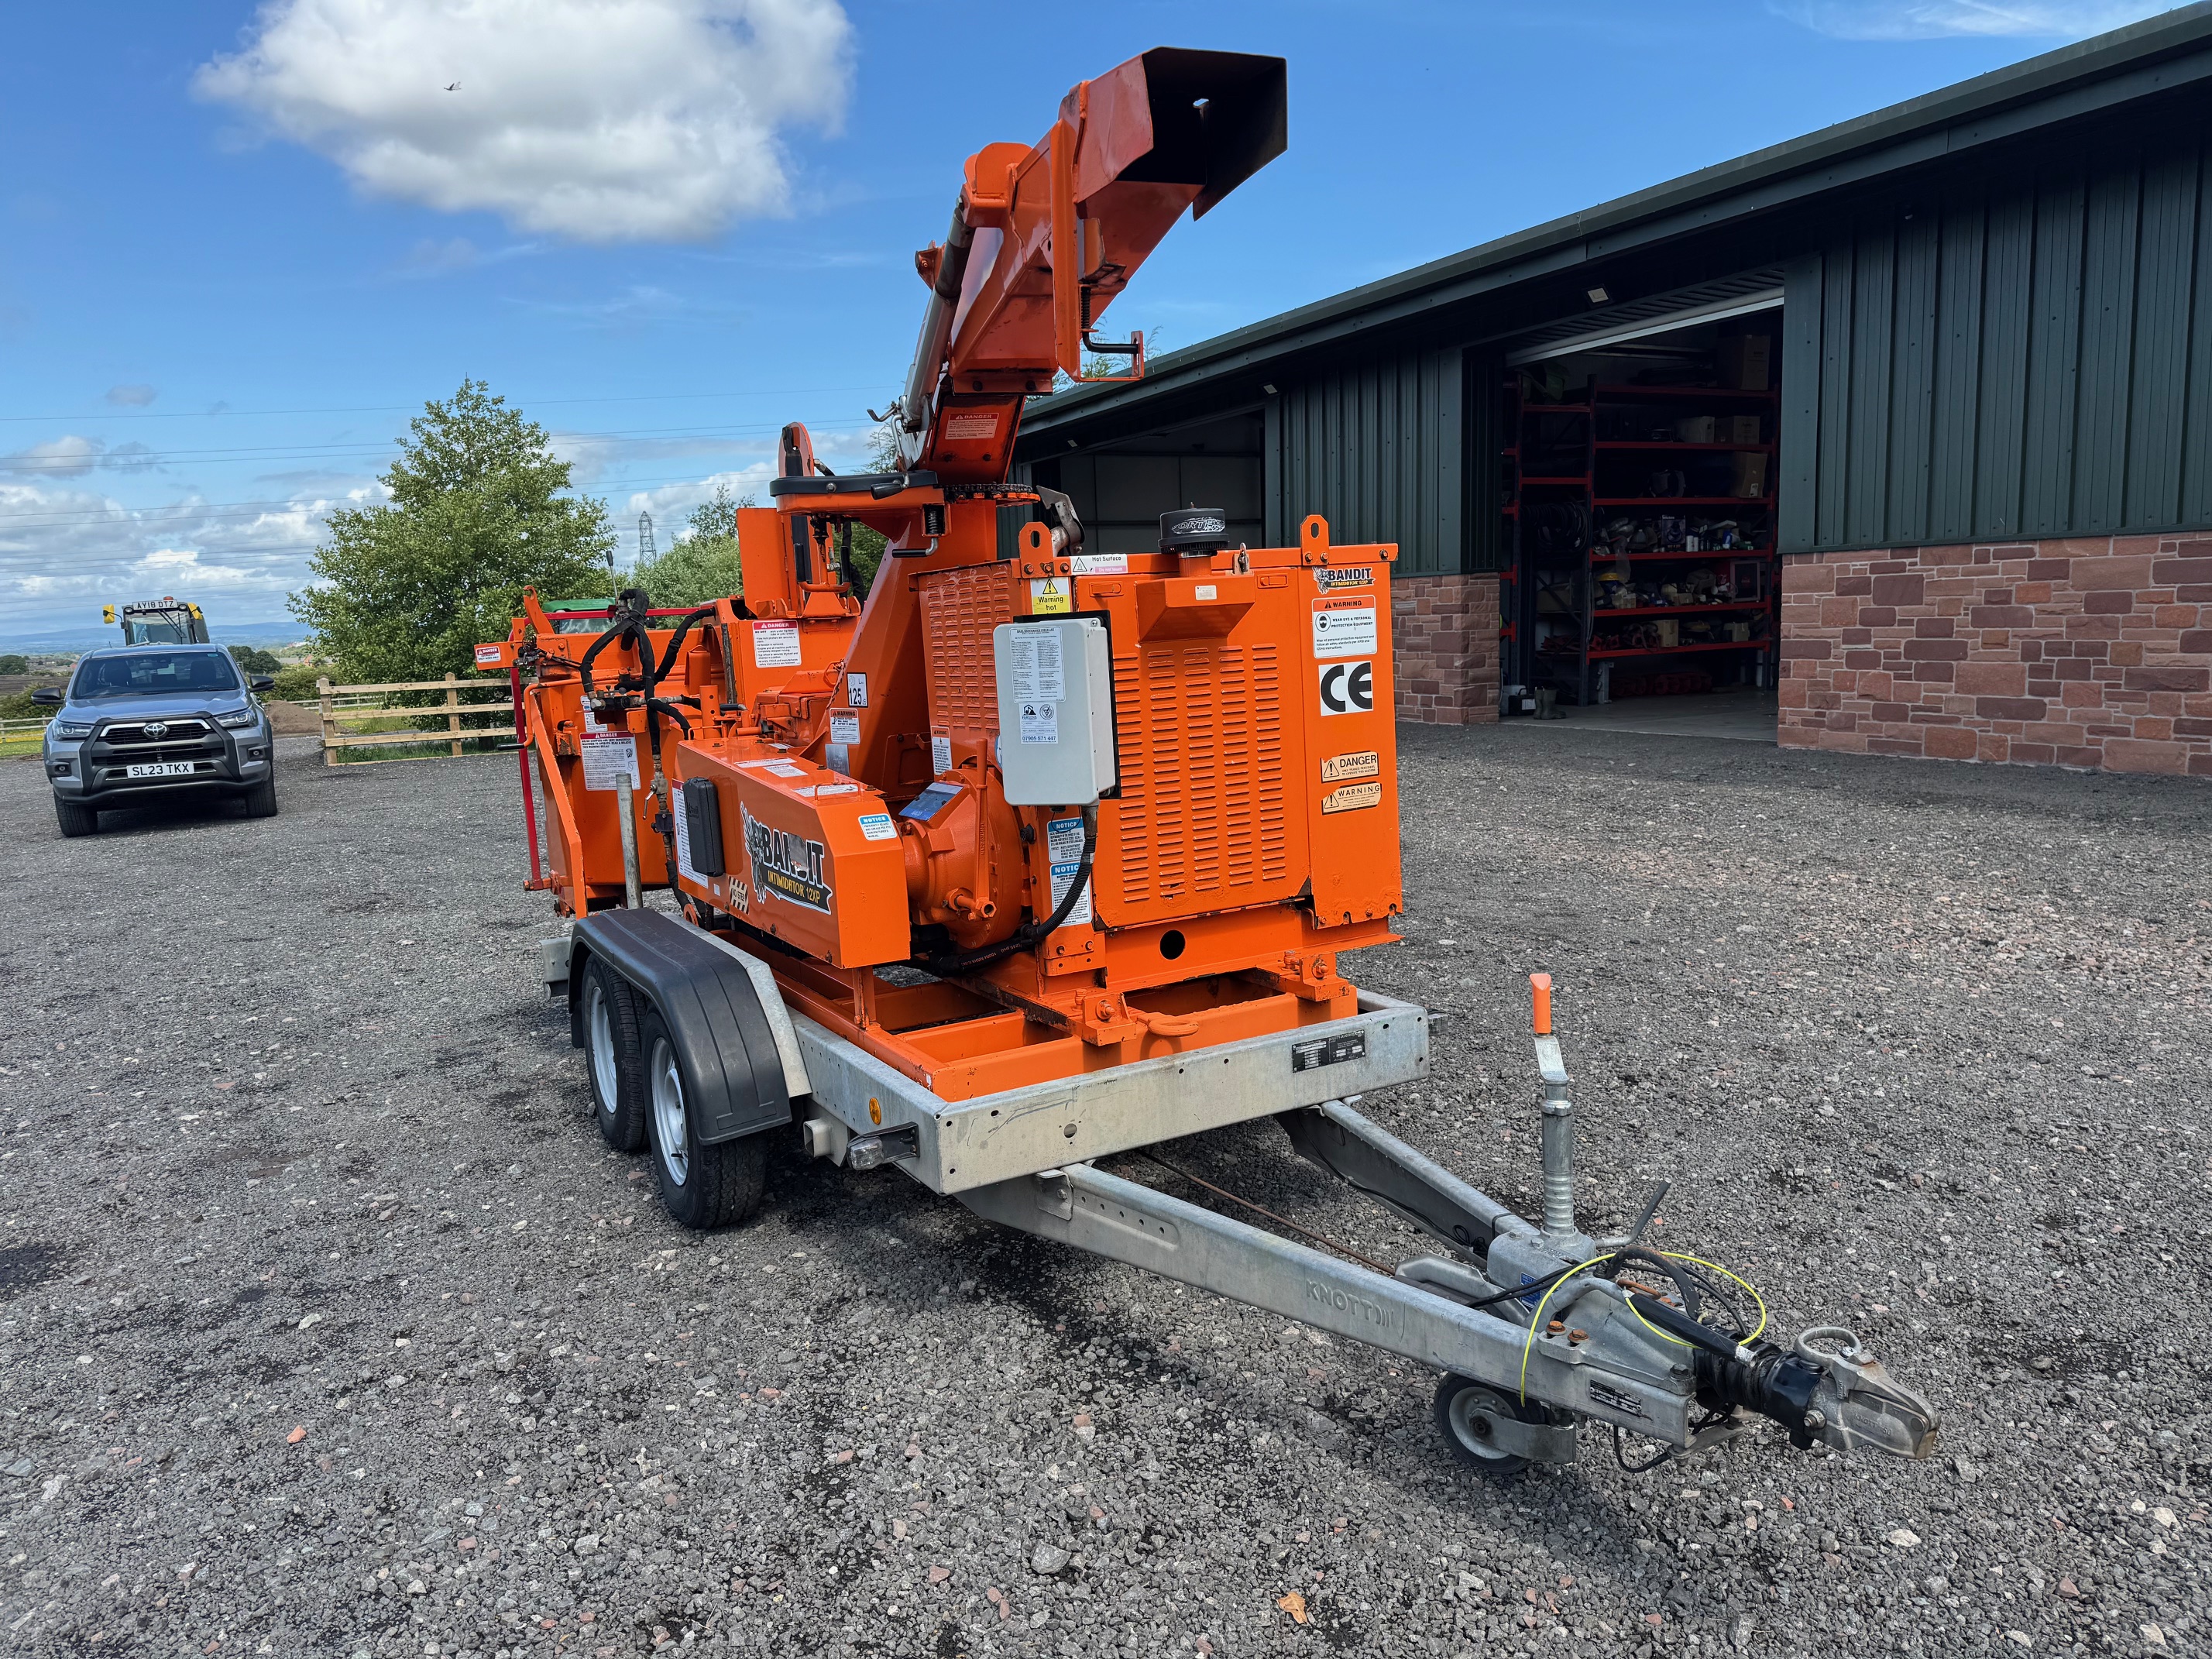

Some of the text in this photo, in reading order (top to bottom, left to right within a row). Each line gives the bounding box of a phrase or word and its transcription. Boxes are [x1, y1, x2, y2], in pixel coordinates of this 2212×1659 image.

[1328, 568, 1372, 581] BANDIT
[1321, 661, 1373, 712] CE
[849, 688, 862, 705] 125
[132, 762, 190, 776] SL23 TKX
[1340, 755, 1376, 768] DANGER
[1338, 785, 1379, 796] WARNING
[761, 823, 825, 888] BANIT
[1055, 864, 1079, 873] NOTIC
[768, 870, 821, 904] INTIMIDATOR 12XP
[1306, 1278, 1374, 1321] KNOTT
